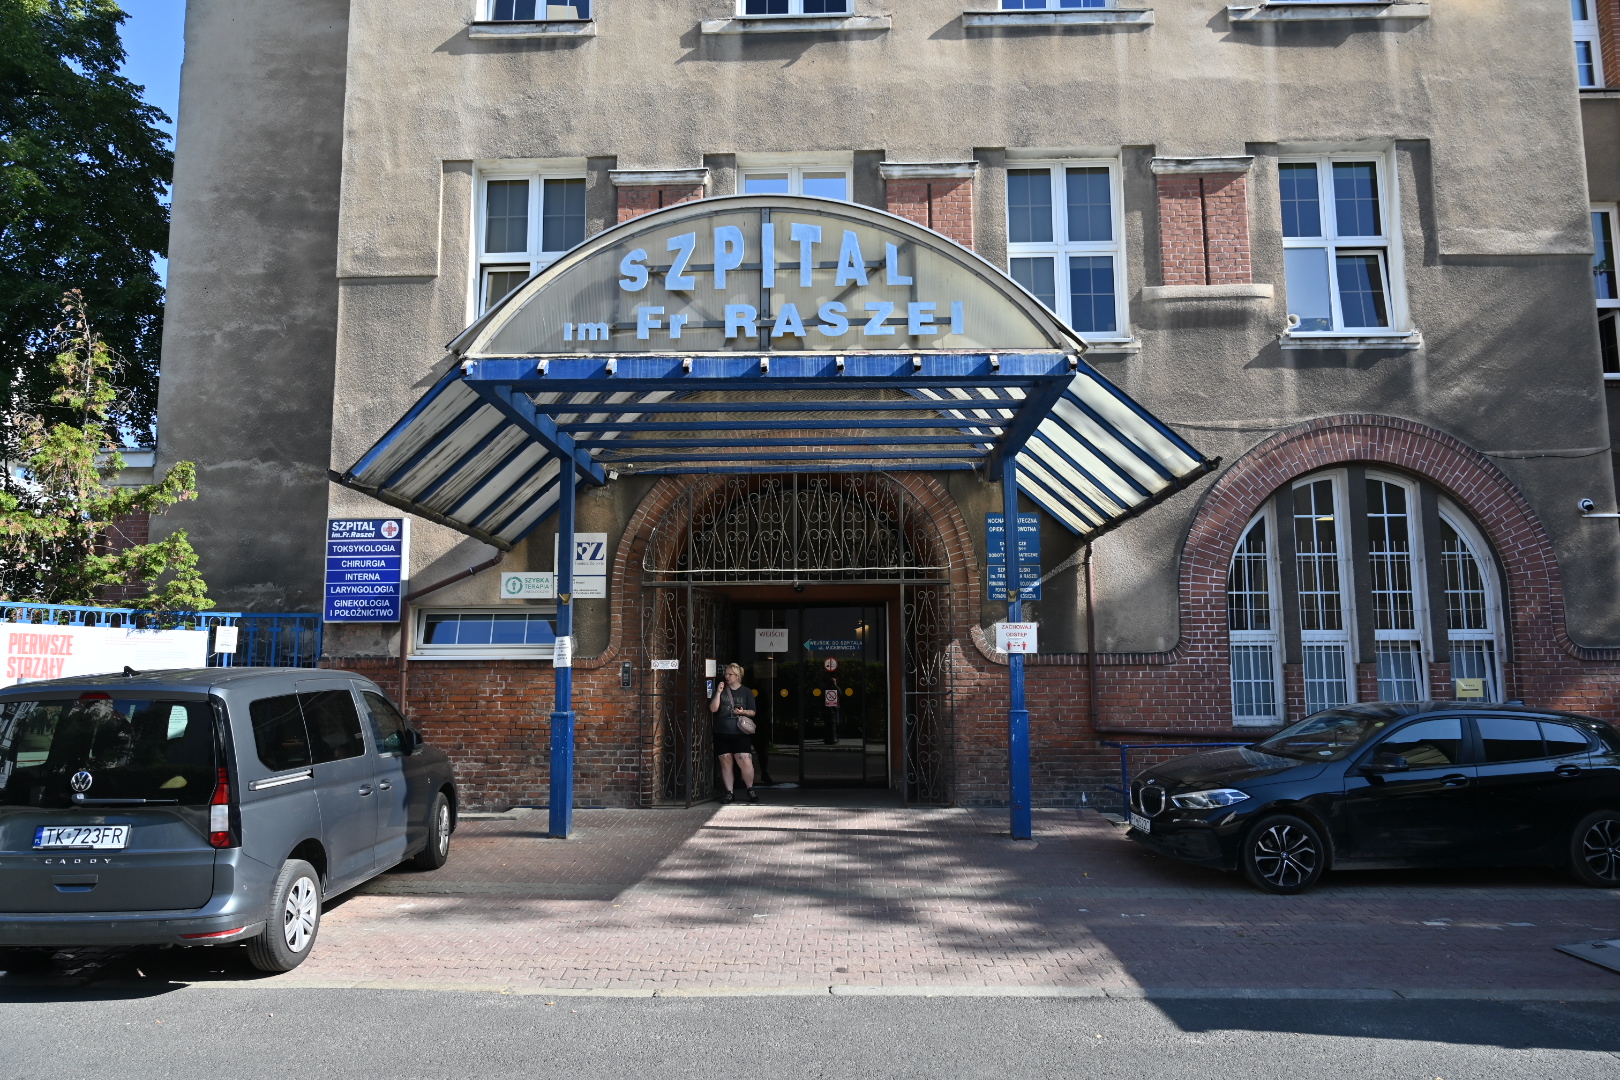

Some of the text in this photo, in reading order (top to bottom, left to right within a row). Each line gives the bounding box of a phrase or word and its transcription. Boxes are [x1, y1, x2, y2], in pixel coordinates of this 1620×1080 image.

[619, 222, 913, 292] SZPITAL
[563, 300, 964, 341] im Fr RASZEI
[331, 521, 376, 531] SZPITAL
[332, 544, 396, 553] TOKSYKOLOGIA
[574, 541, 605, 560] FZ
[341, 560, 386, 568] CHIRURGIA
[345, 573, 381, 581] INTERNA
[330, 585, 395, 594] LARYNGOLOGIA
[334, 599, 390, 607] GINEKOLOGIA
[334, 608, 394, 617] POŁOŻNICTWO
[759, 630, 785, 638] WEJŚCIE
[8, 632, 74, 656] PIERWSZE
[6, 656, 65, 679] STRZAŁY
[46, 827, 123, 845] TK 723FR
